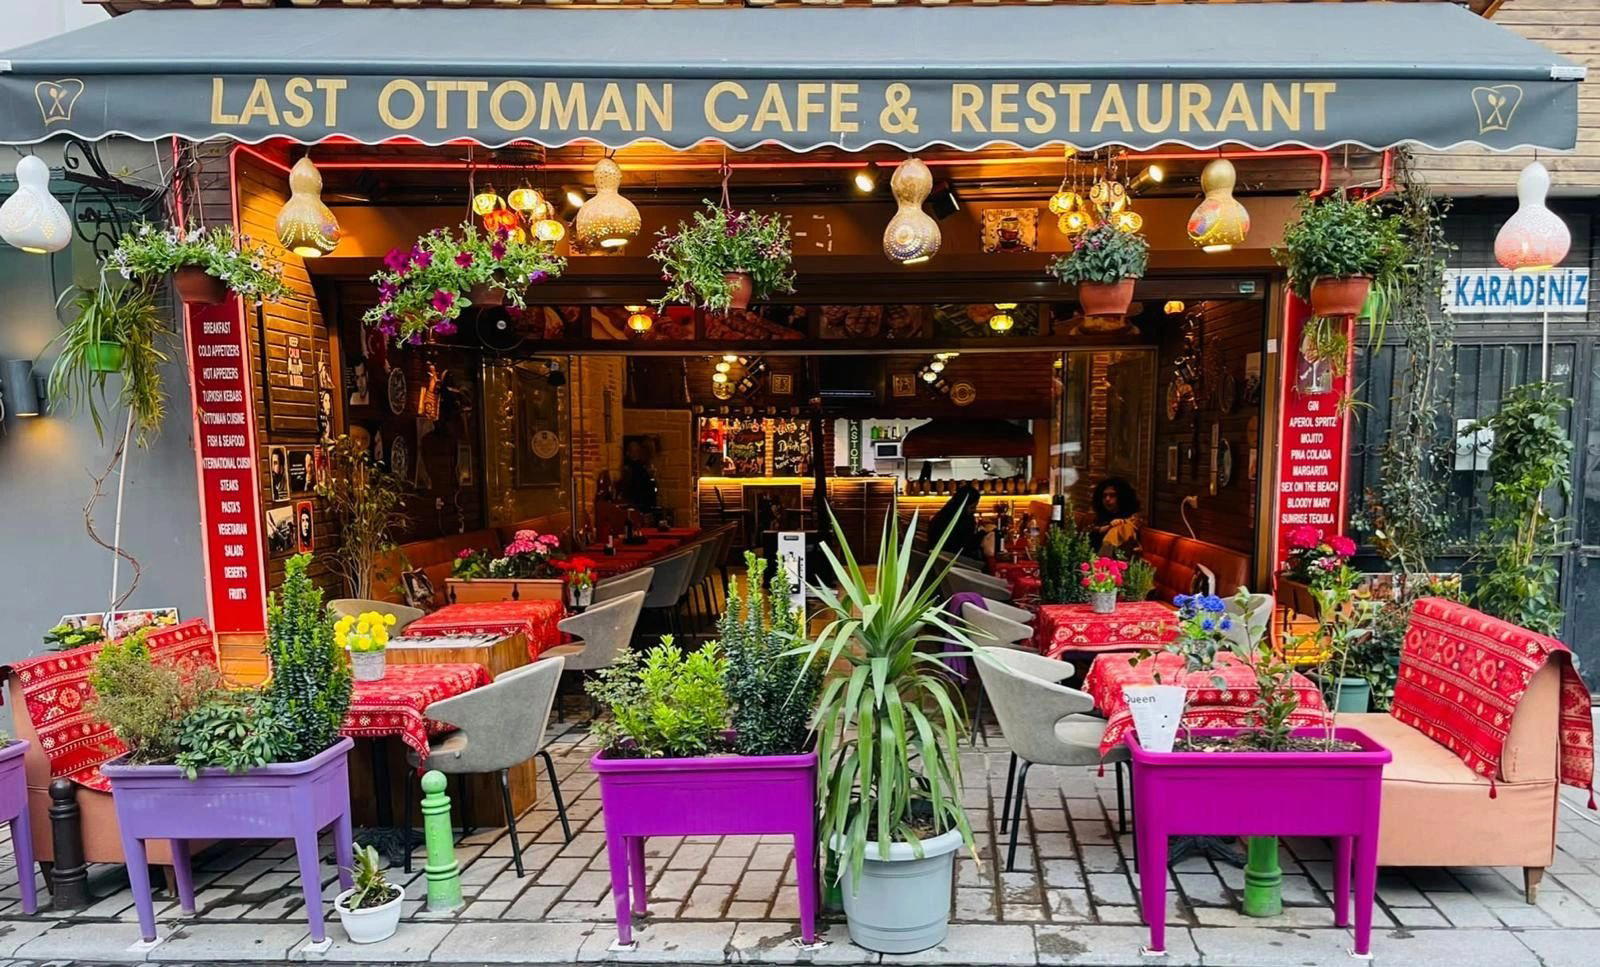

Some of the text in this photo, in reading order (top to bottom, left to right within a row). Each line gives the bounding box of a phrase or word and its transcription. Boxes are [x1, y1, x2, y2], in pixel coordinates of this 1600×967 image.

[211, 77, 1337, 134] LAST OTTOMAN CAFE & RESTAURANT
[1455, 270, 1588, 306] KARADENİZ
[203, 322, 231, 334] BREAKFAST
[198, 345, 211, 356] COLD
[203, 368, 213, 379] HOT
[202, 391, 243, 402] TURKISH KEBABS
[1308, 401, 1319, 411] GIN
[203, 413, 246, 424] OTTOMAN CUISINE
[1289, 417, 1337, 427] APEROL SPRITZ
[207, 435, 218, 446] FISH
[222, 435, 246, 447] SEAFOOD
[1300, 433, 1324, 443] MOJITO
[1306, 450, 1332, 460] COLADA
[203, 457, 236, 469] NTERNATIONAL
[1292, 466, 1329, 476] MARGARITA
[219, 479, 240, 491] STEAKS
[1281, 482, 1339, 492] SEX ON THE BEACH
[1287, 498, 1331, 508] BLOODY MARY
[1281, 514, 1335, 524] SUNRISE TEQUILA
[217, 523, 248, 535] VEGETARIAN
[223, 544, 244, 557] SALADS
